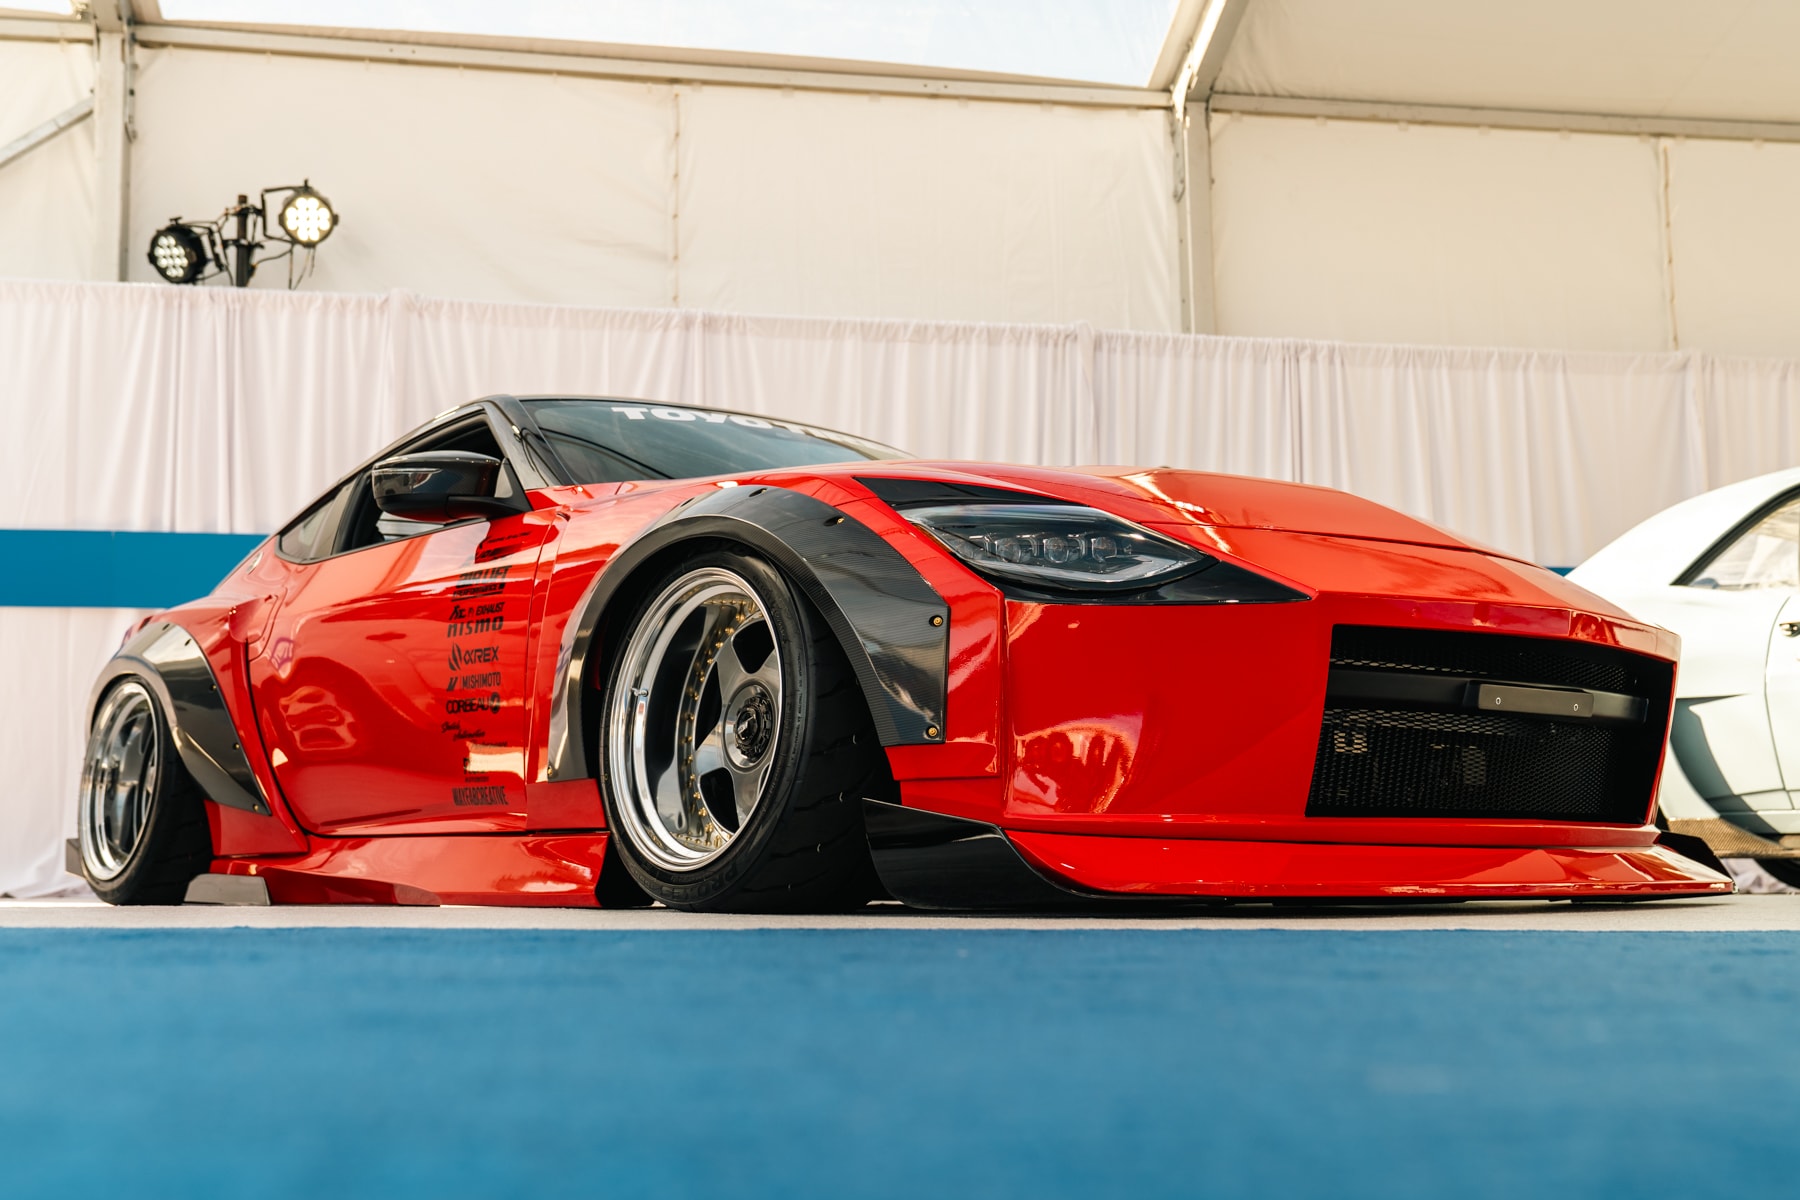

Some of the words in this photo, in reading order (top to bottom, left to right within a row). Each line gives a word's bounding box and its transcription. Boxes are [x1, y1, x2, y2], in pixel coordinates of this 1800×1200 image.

[611, 406, 774, 429] TOYO
[463, 671, 502, 689] MISHIMOTO
[445, 697, 489, 714] CORBEAU
